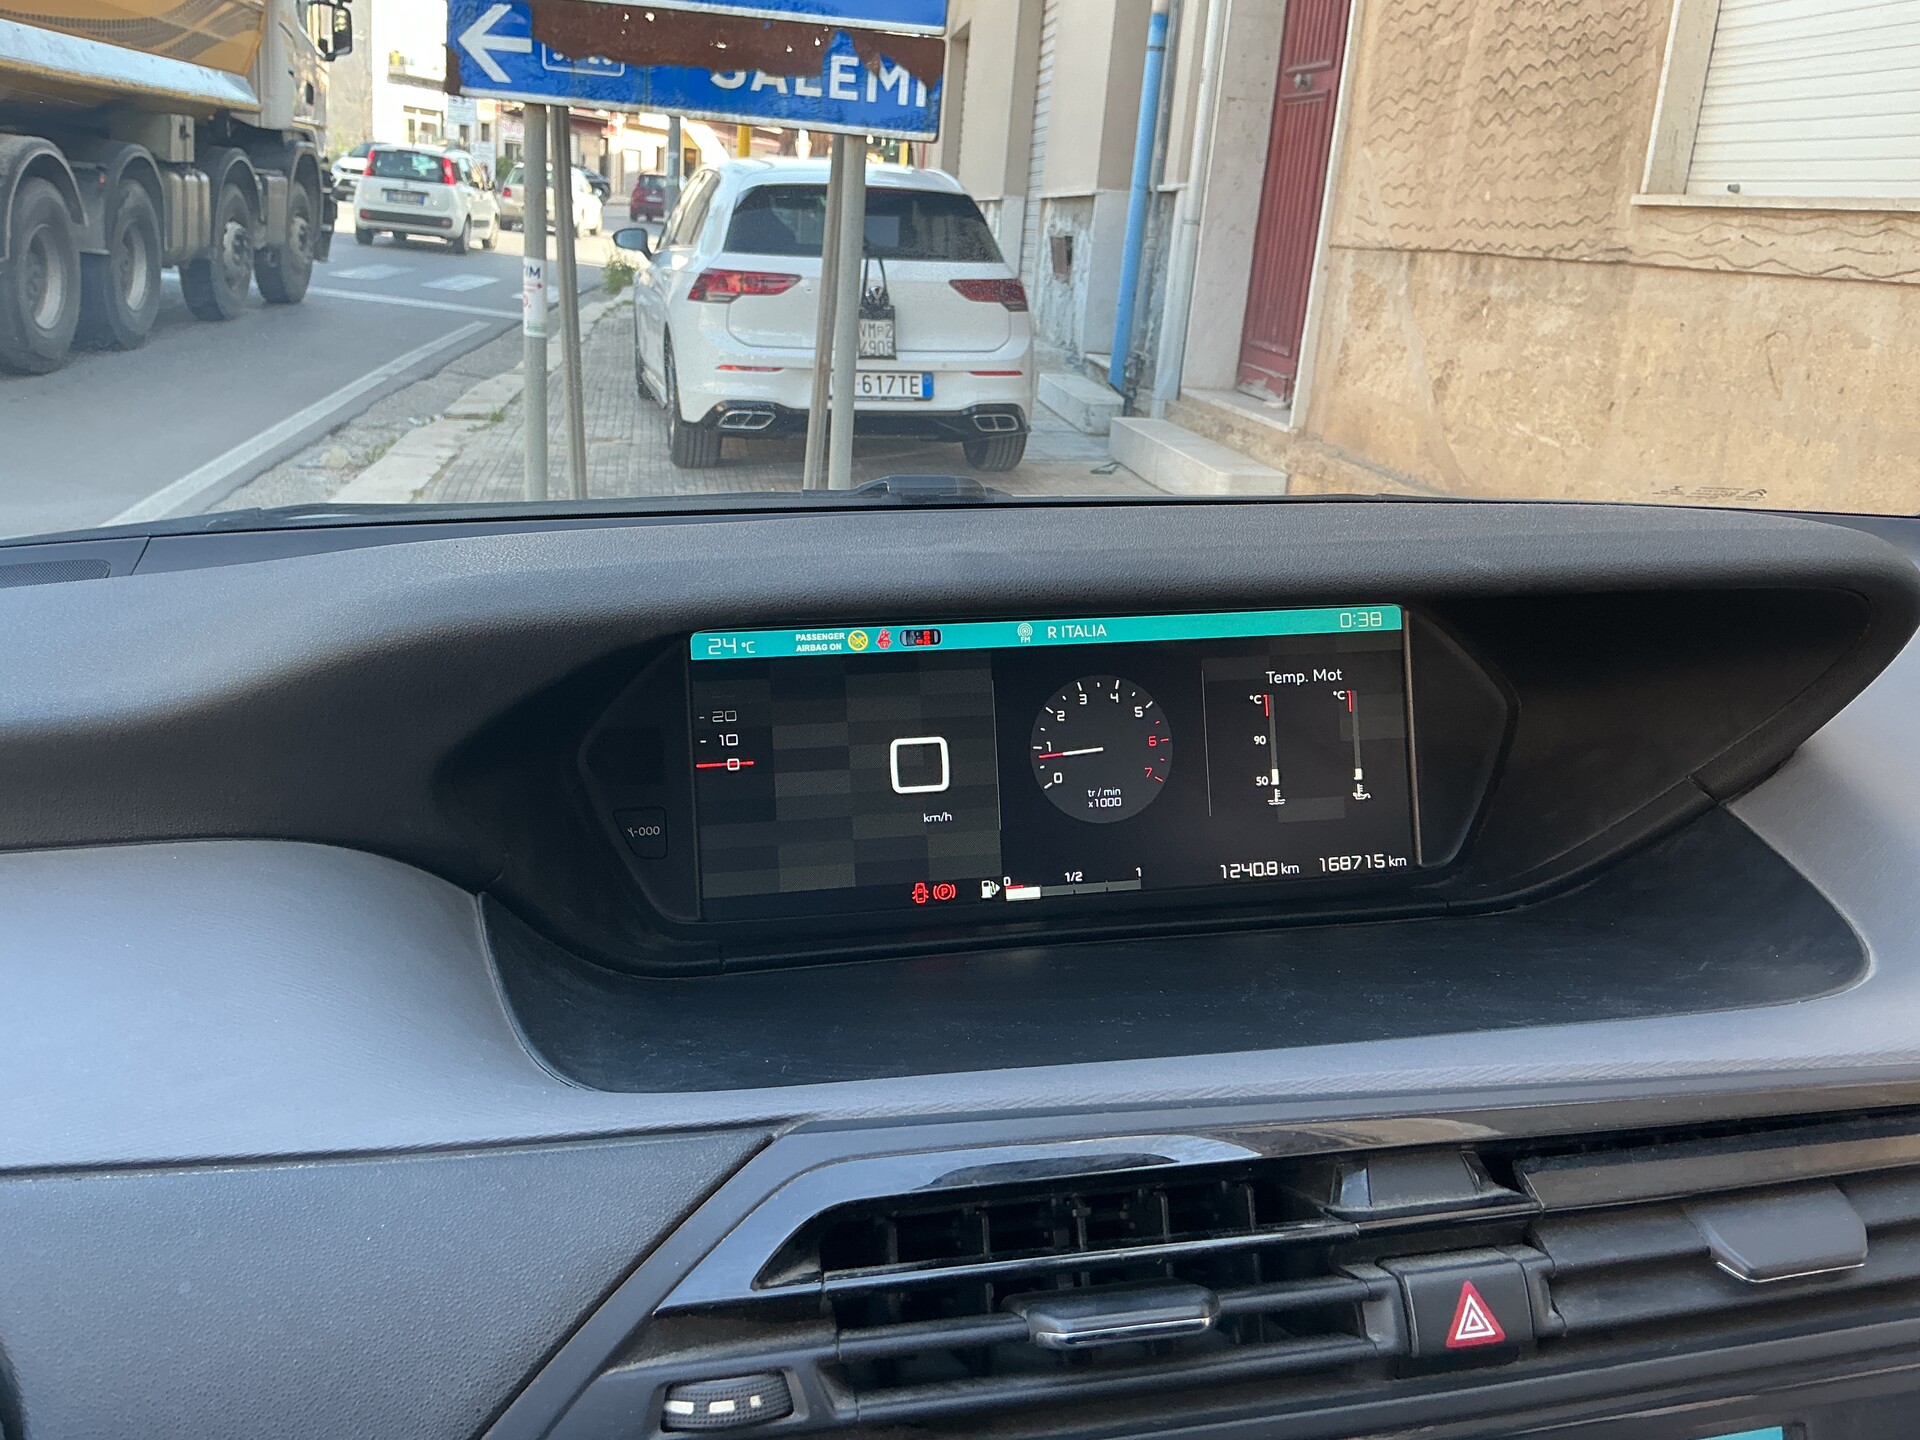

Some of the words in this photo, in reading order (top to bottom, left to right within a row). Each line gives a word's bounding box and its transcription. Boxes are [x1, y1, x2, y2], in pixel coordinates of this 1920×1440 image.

[1340, 611, 1382, 628] 0:38
[795, 632, 845, 642] PASSENGER
[1047, 626, 1057, 639] R
[1061, 623, 1107, 638] ITALIA
[707, 637, 737, 655] 24
[795, 643, 827, 652] AIRBAG
[829, 643, 842, 651] ON
[1265, 671, 1309, 686] Temp.
[1313, 668, 1343, 682] Mot
[1078, 693, 1088, 705] 3
[1109, 692, 1120, 704] 4
[712, 710, 737, 723] 20
[1056, 710, 1066, 722] 2
[1134, 706, 1143, 718] 5
[718, 733, 739, 747] 10
[1148, 735, 1157, 747] 6
[1253, 735, 1267, 745] 90
[1046, 741, 1052, 753] 1
[1053, 772, 1063, 784] 0
[1144, 767, 1153, 778] 7
[1255, 776, 1269, 786] 50
[1087, 797, 1122, 808] x1000
[923, 812, 953, 823] km/h
[1318, 853, 1385, 873] 168715
[1388, 855, 1407, 868] km
[1135, 866, 1142, 877] 1
[1220, 860, 1278, 879] 1240.8
[1280, 862, 1300, 875] km
[1003, 876, 1012, 887] 0
[1064, 871, 1083, 882] 1/2
